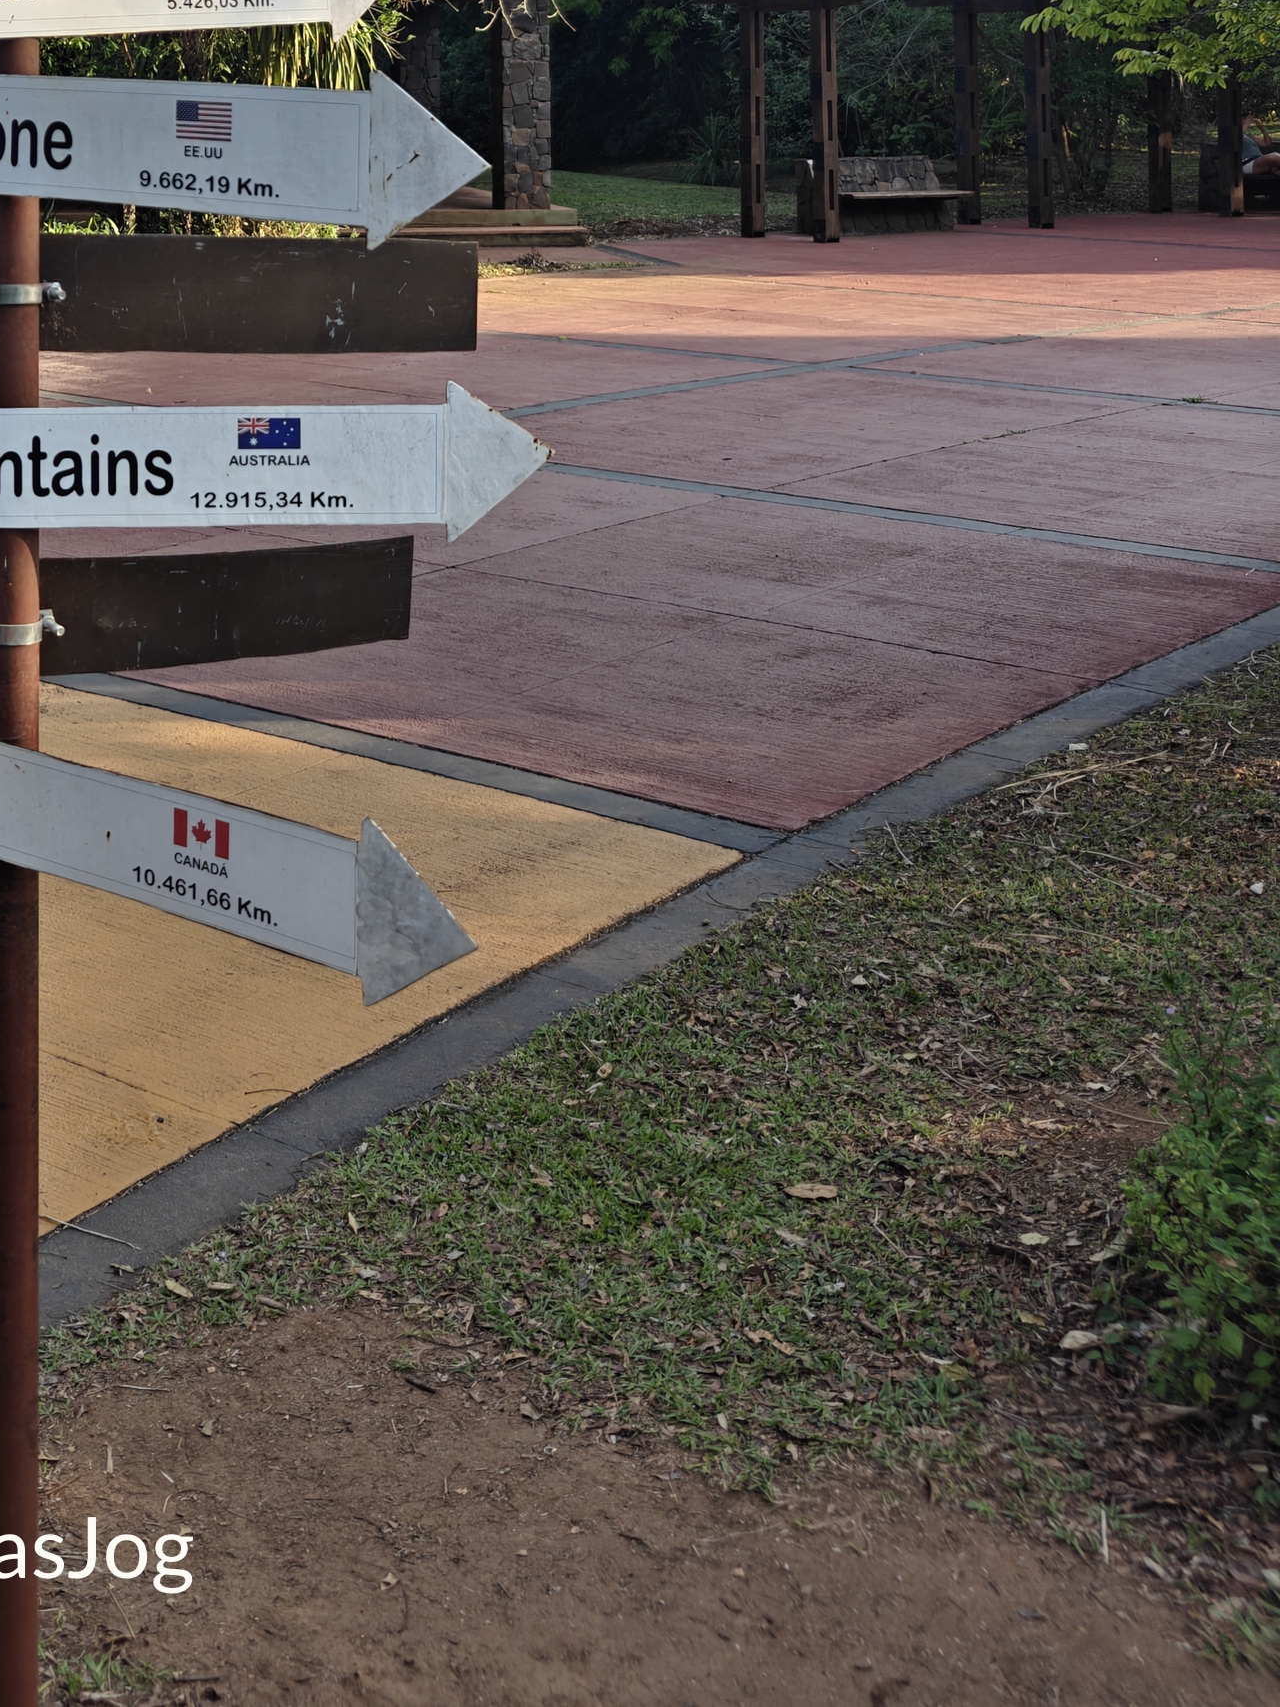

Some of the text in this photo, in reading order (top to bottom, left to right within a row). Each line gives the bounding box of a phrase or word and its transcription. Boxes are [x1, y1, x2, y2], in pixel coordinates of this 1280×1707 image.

[184, 145, 223, 159] EE.UU
[139, 170, 279, 198] 9.662,19 Km.
[229, 455, 310, 466] AUSTRALIA
[190, 491, 354, 511] 12.915,34 Km.
[174, 851, 229, 879] CANADÁ
[132, 865, 278, 927] 10.461,66 Km.
